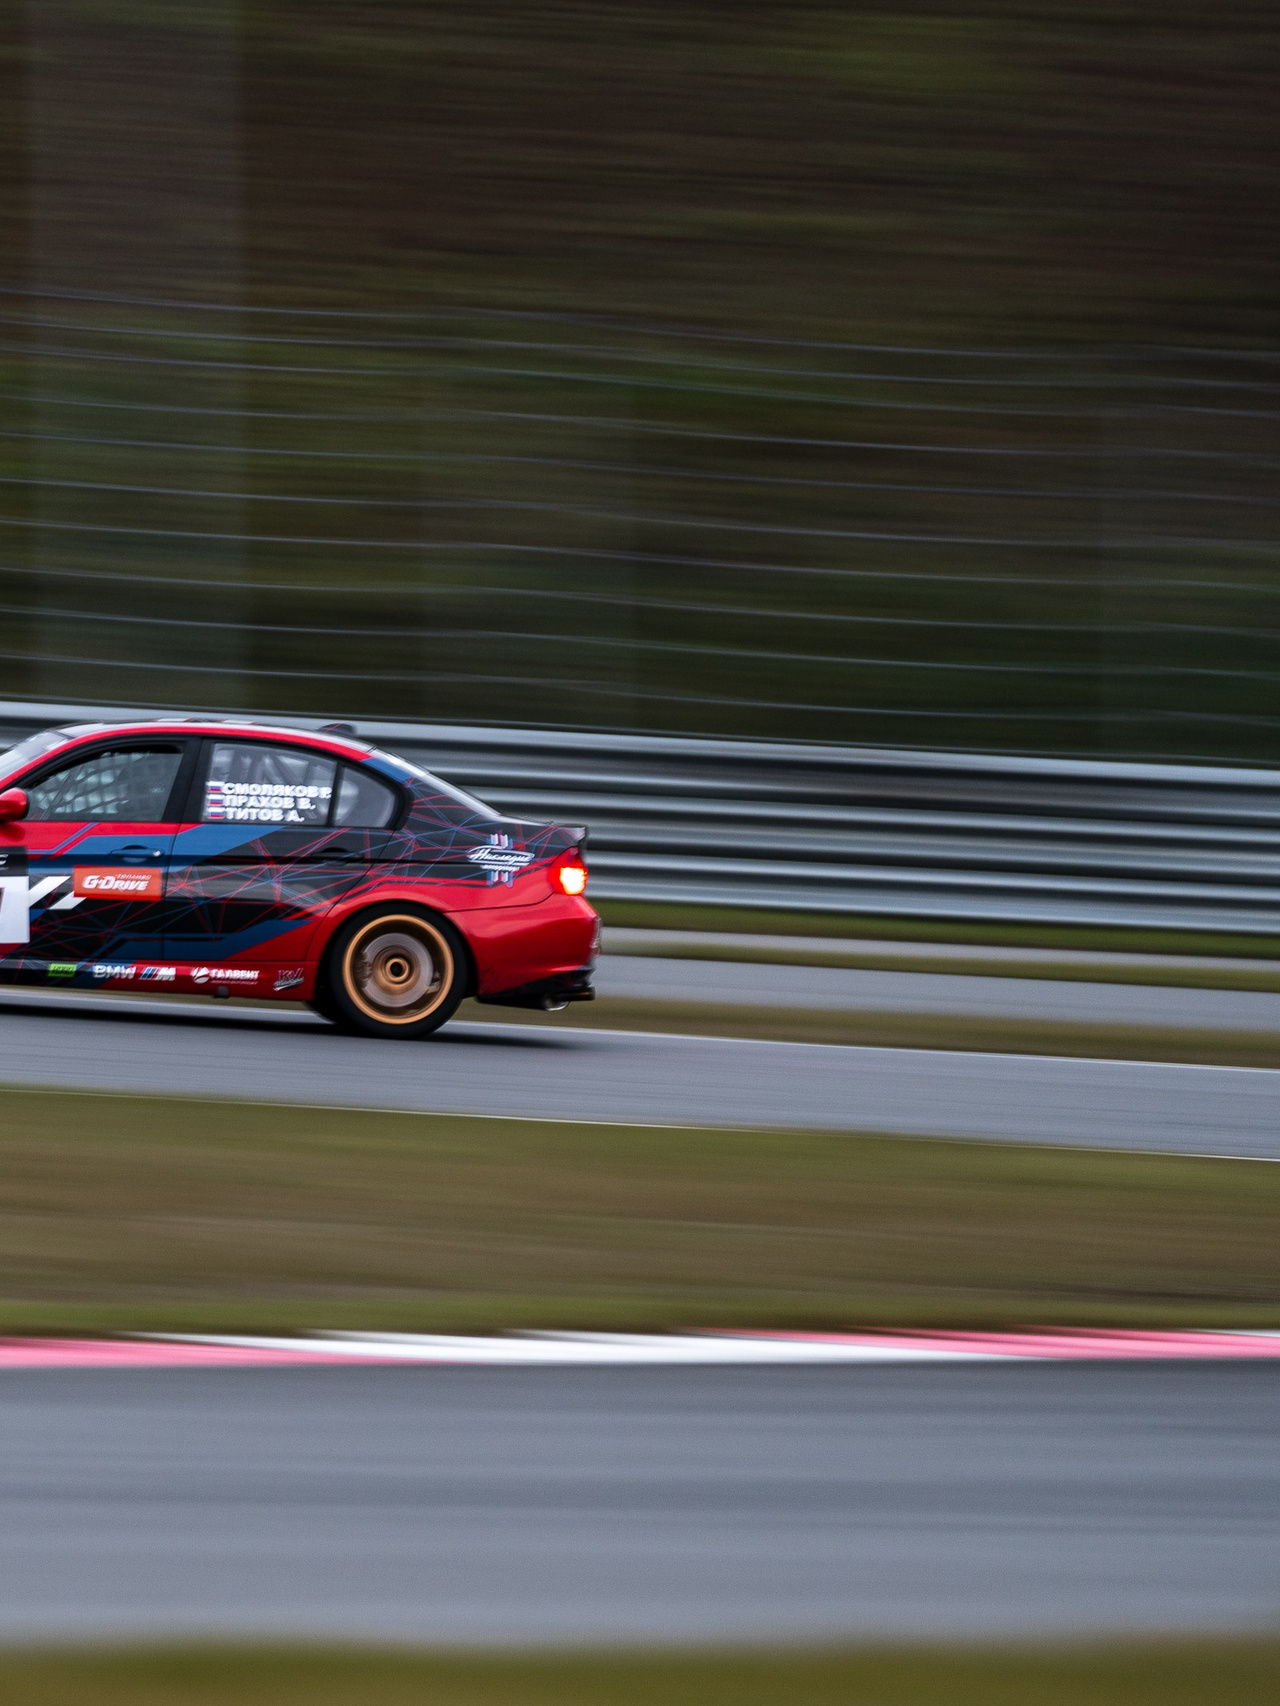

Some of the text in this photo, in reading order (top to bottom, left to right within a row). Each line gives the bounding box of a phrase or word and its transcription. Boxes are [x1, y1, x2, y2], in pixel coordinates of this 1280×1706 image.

[222, 783, 320, 798] СМОЛЯКОВ
[224, 794, 295, 809] ПРАХОВ
[225, 807, 284, 821] ТИТОВ
[92, 965, 136, 980] BMW
